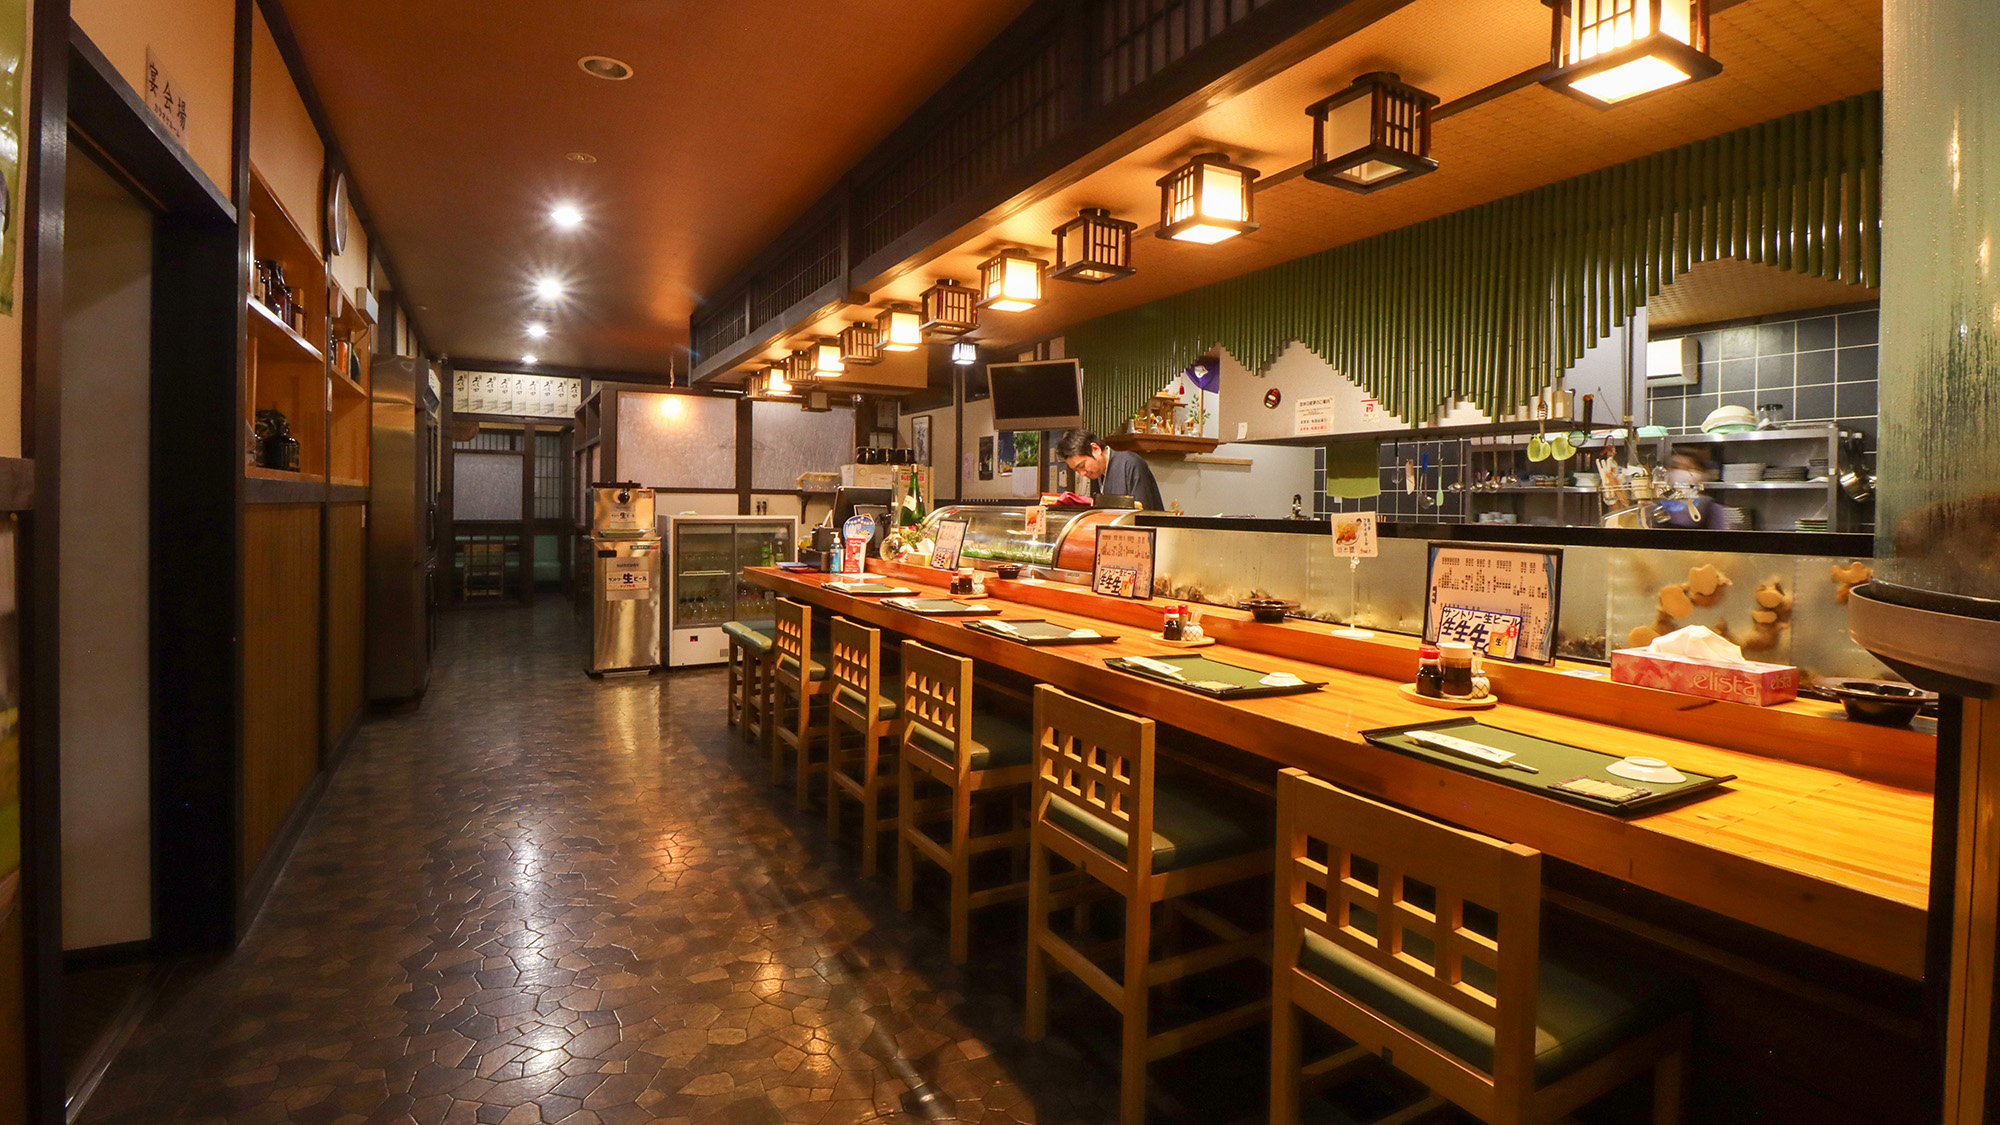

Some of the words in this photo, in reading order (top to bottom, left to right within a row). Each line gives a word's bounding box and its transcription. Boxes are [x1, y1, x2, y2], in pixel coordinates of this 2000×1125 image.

[149, 62, 187, 131] 宴会場
[608, 573, 647, 584] サントリー生ビール
[1099, 573, 1122, 594] 生生生
[1443, 608, 1520, 627] サントリー生ビール
[1693, 671, 1758, 698] elista
[1770, 675, 1792, 690] elista
